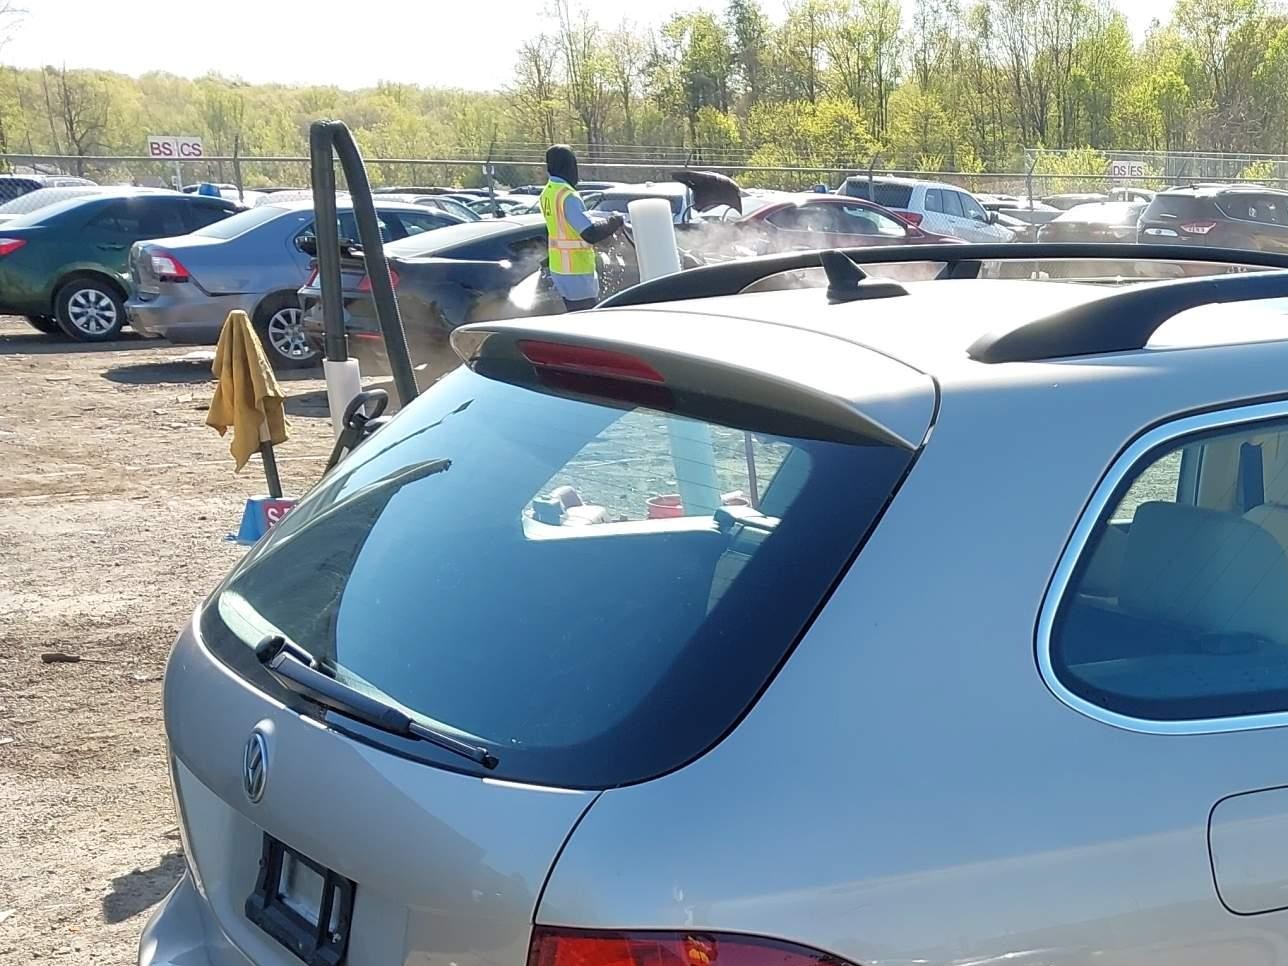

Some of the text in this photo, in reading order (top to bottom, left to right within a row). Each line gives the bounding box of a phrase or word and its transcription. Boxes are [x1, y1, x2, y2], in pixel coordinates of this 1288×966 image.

[150, 141, 202, 157] BS CS
[1113, 165, 1143, 176] DS ES
